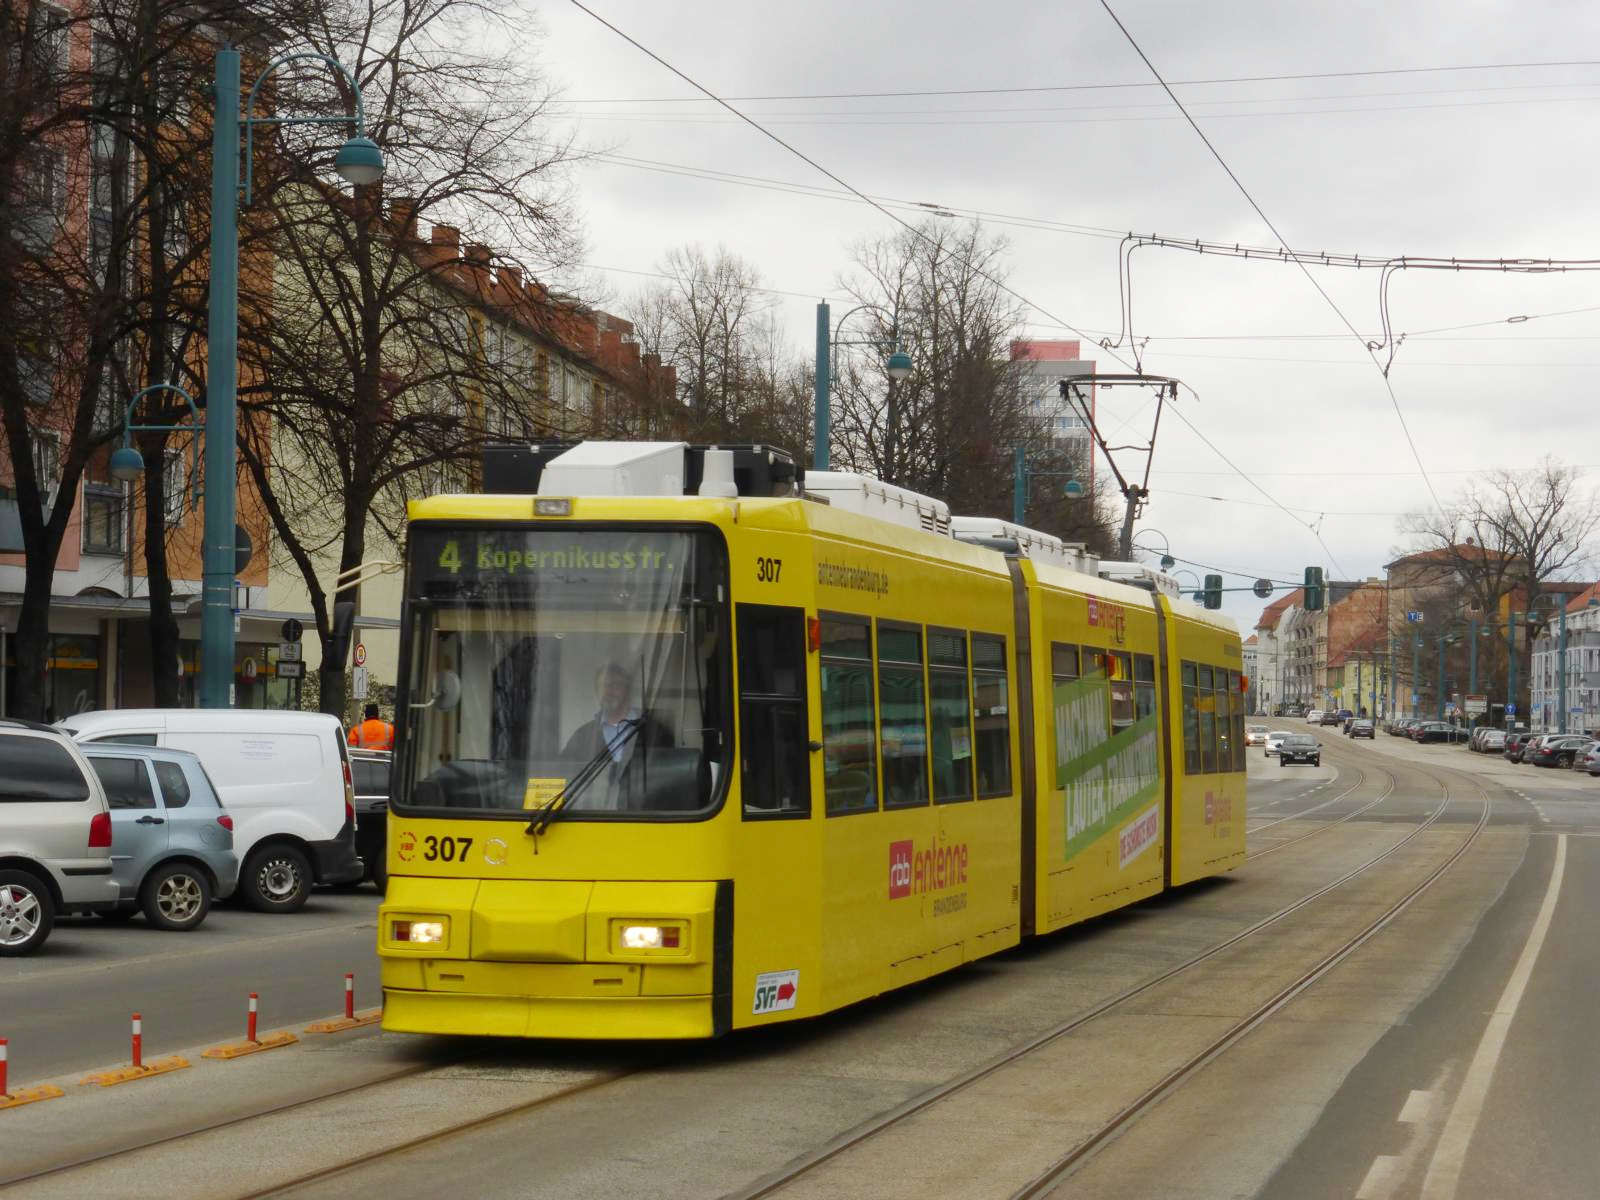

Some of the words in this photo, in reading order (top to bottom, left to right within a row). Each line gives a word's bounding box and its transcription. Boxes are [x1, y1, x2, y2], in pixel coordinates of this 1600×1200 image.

[439, 541, 462, 574] 4
[477, 544, 673, 574] Kopernikusstr.
[757, 557, 782, 583] 307
[423, 835, 473, 862] 307
[890, 851, 911, 888] rbb
[914, 836, 968, 896] Antenne
[755, 985, 777, 1010] SVF
